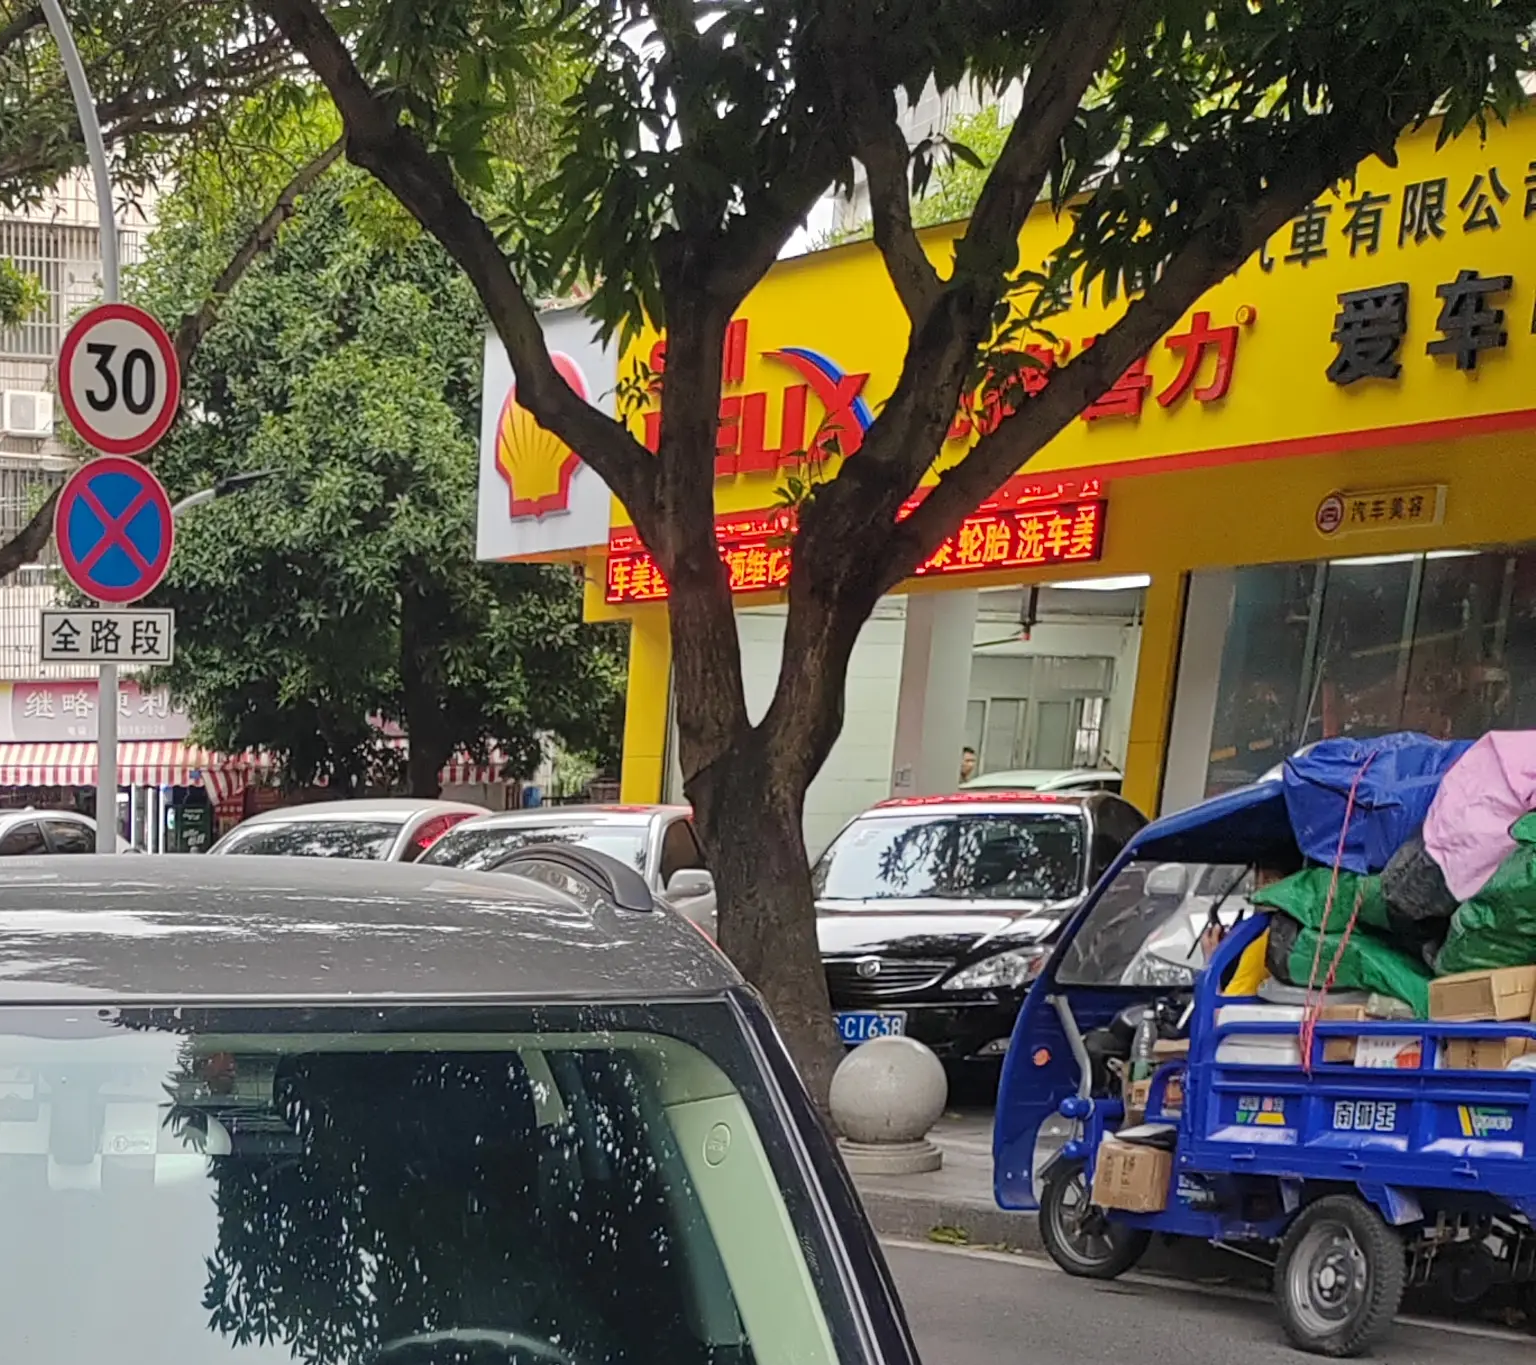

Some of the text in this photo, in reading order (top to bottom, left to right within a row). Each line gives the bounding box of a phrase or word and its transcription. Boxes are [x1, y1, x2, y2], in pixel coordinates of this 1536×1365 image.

[1260, 162, 1536, 273] 車有限公
[1325, 269, 1536, 386] 爱车
[85, 343, 156, 416] 30
[51, 618, 162, 656] 全路段
